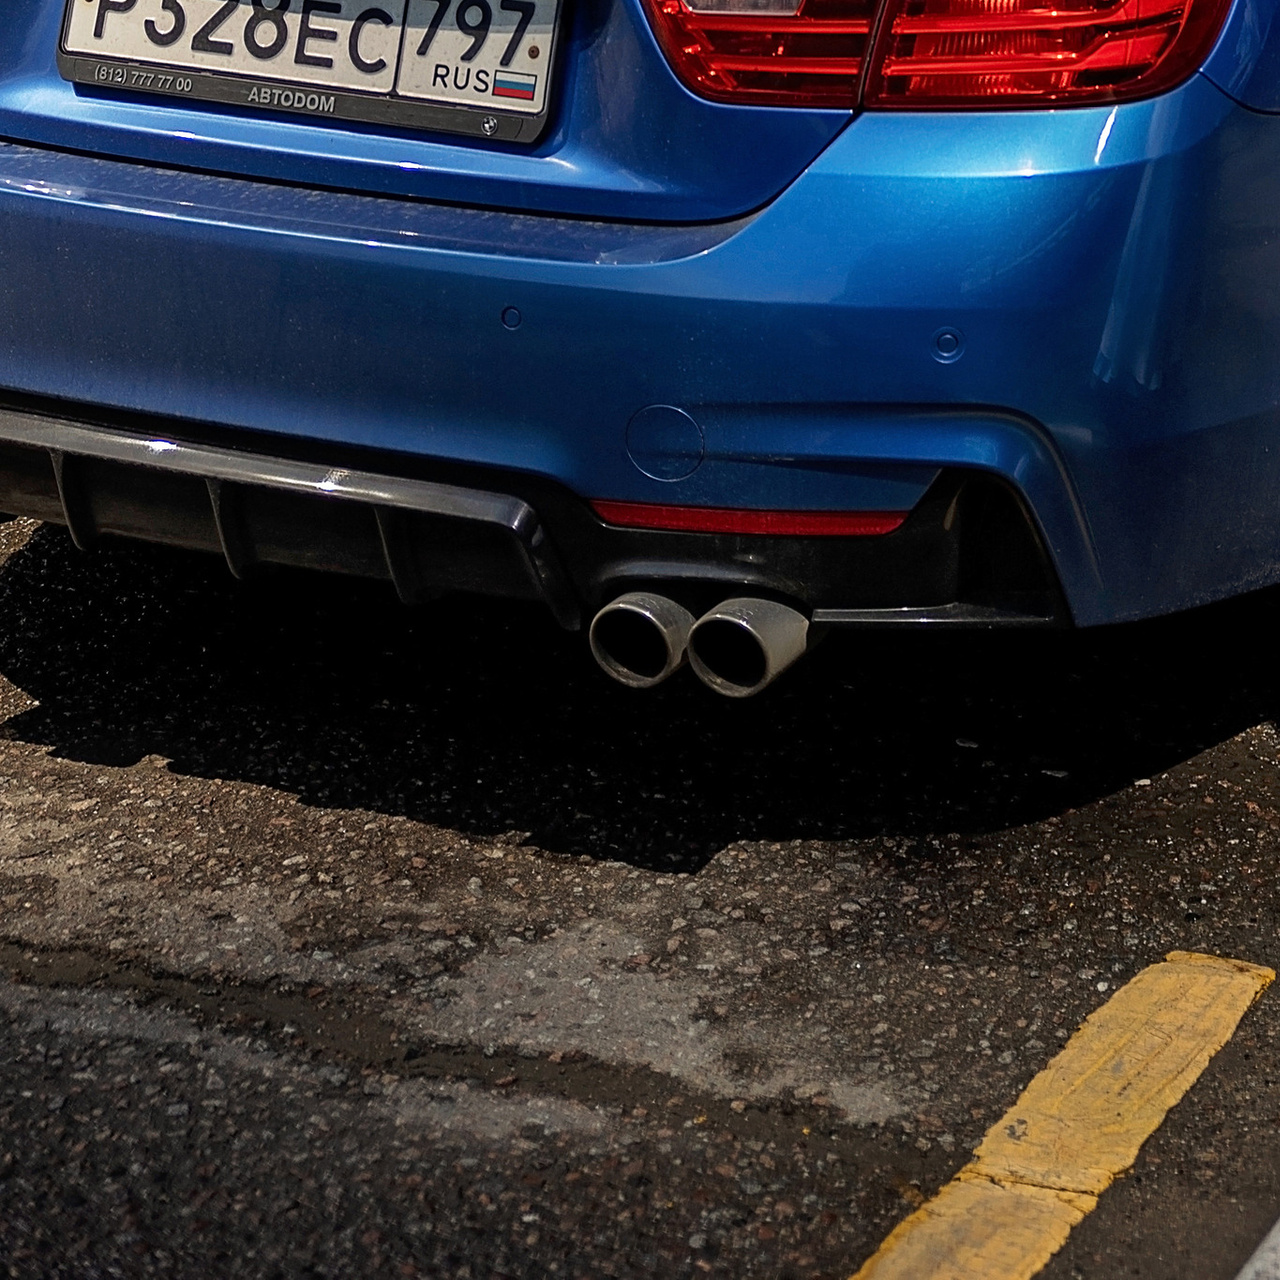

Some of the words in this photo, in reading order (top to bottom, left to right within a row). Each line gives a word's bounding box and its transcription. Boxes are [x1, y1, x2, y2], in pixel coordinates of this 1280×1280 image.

[94, 64, 128, 83] (812)
[131, 70, 155, 88] 777
[157, 74, 175, 90] 77
[176, 76, 193, 92] 00
[432, 63, 490, 94] RUS
